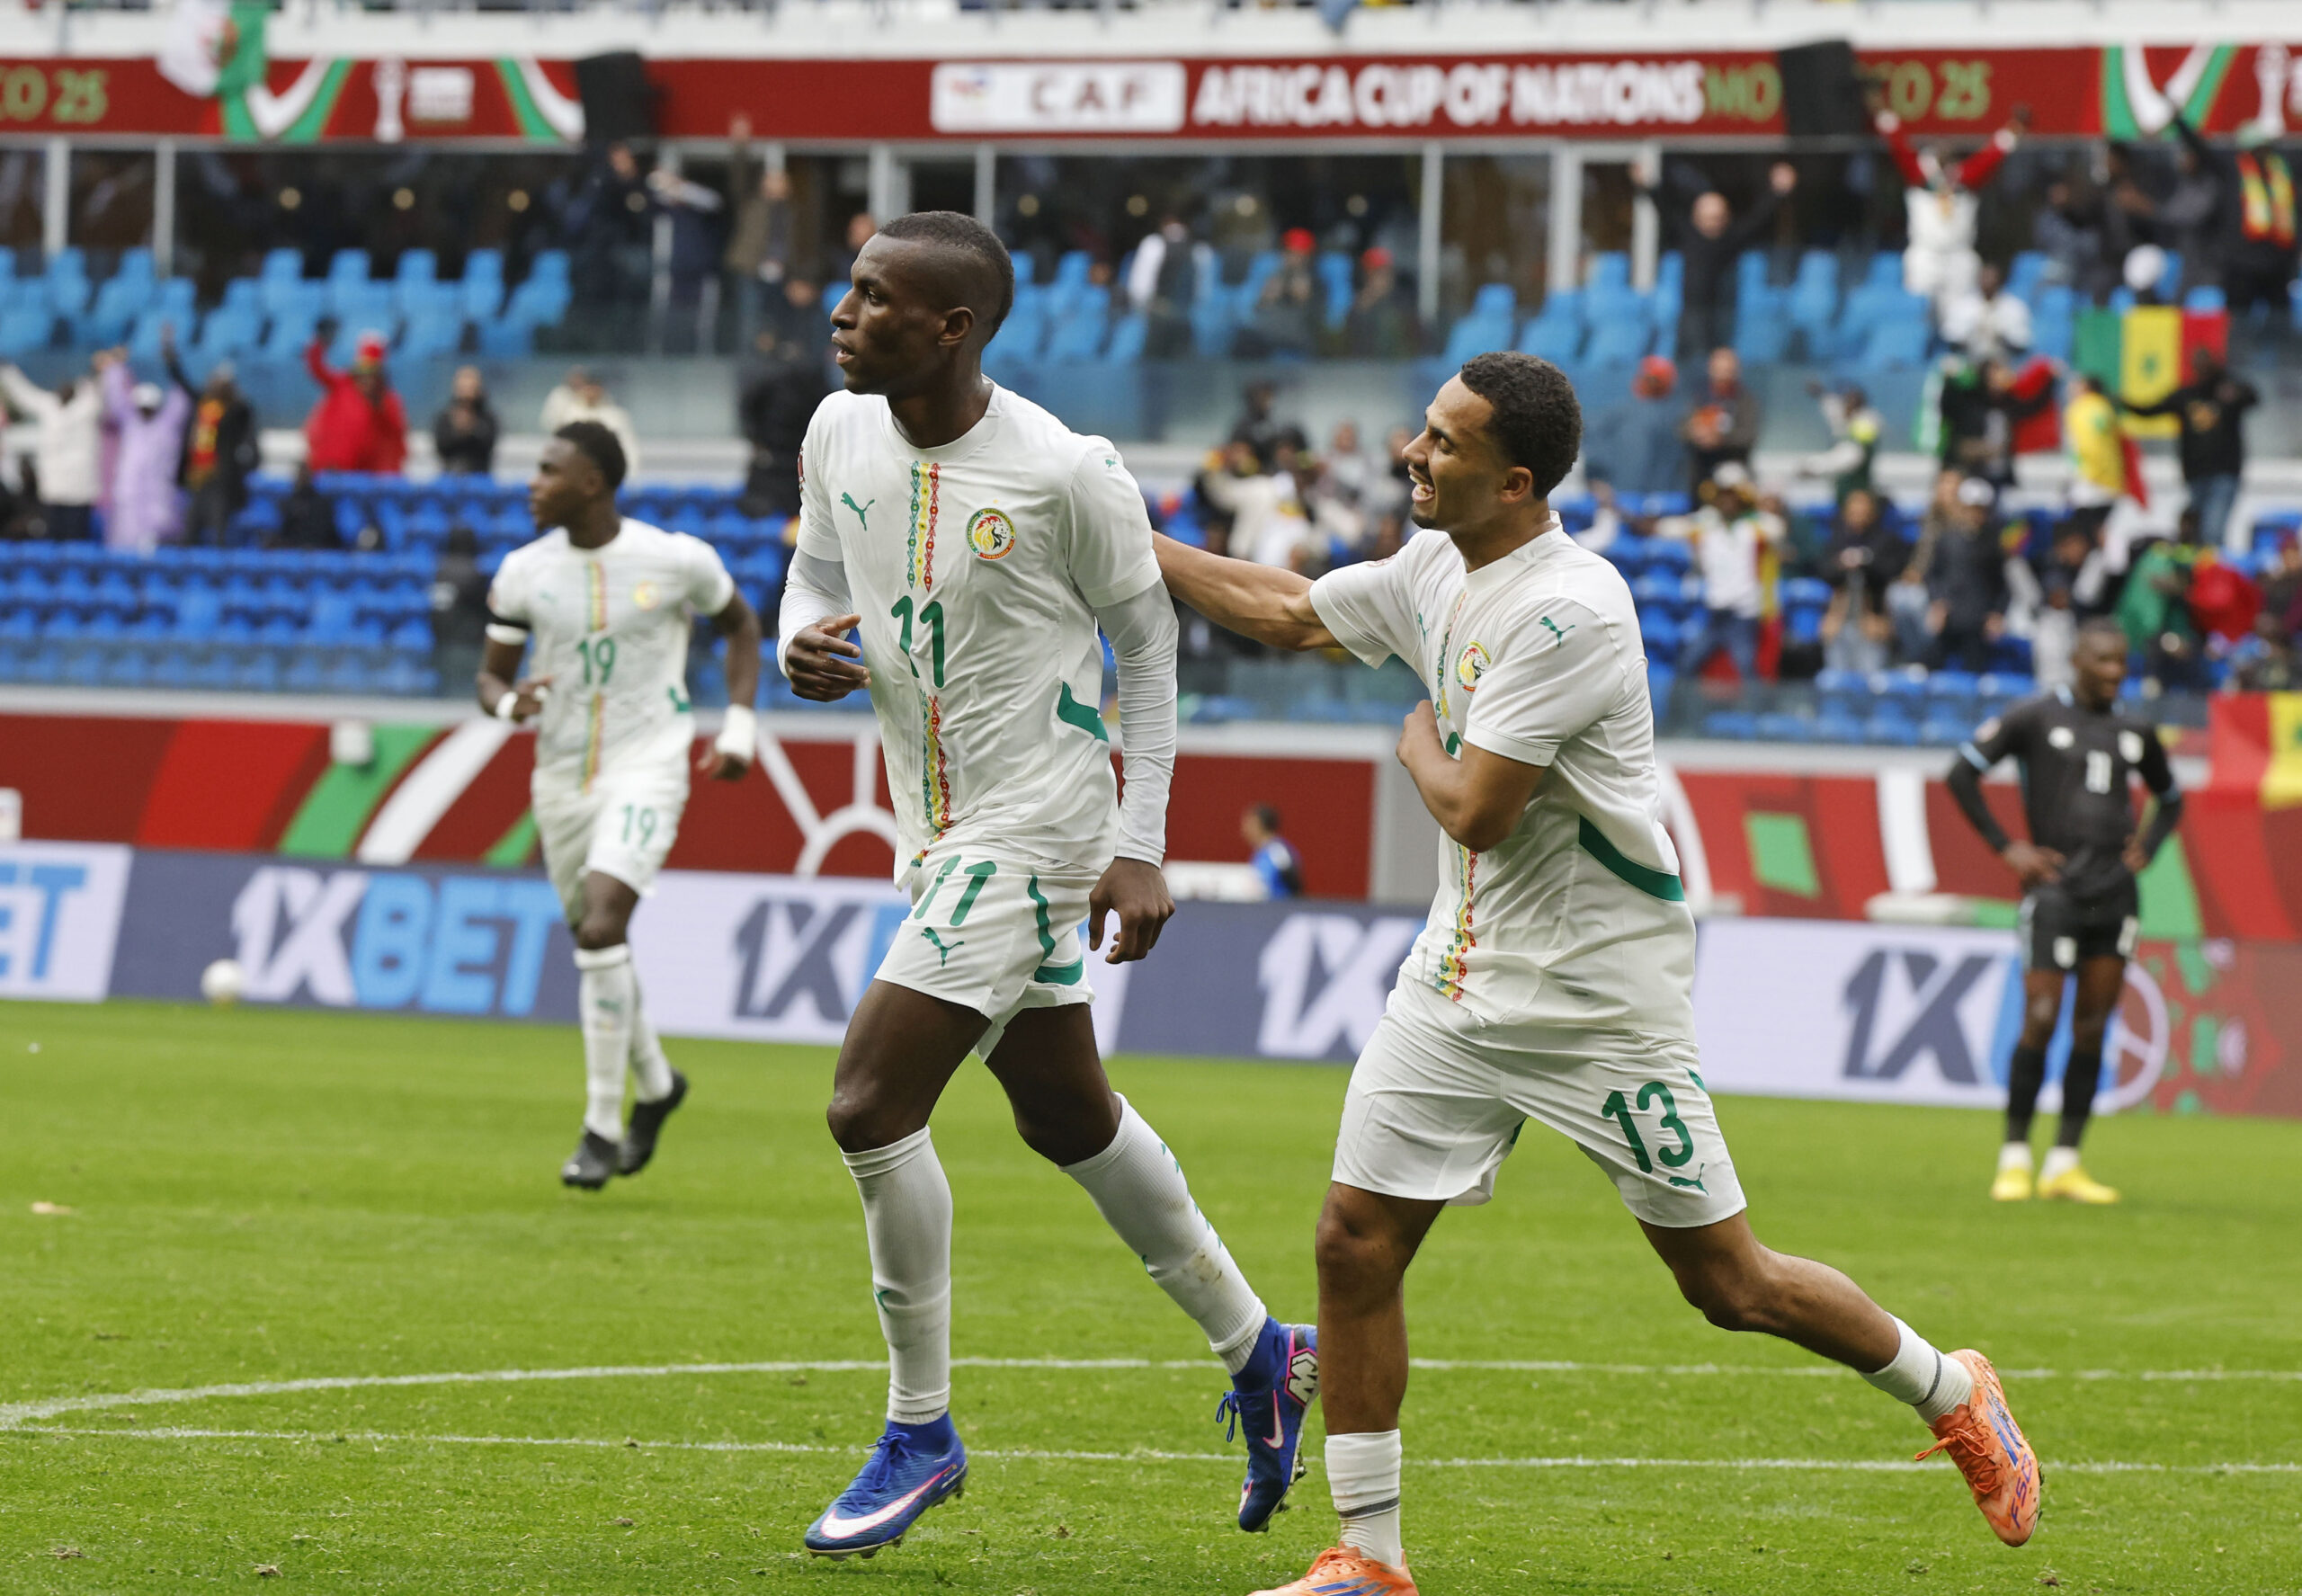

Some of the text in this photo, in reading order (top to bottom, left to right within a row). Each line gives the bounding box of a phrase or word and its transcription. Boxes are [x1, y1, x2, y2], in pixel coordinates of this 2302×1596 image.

[0, 64, 48, 122] O
[1029, 69, 1148, 117] CAF
[1191, 65, 1351, 127] AFRICA
[1352, 63, 1441, 128] CUP
[1442, 62, 1511, 127] OF
[1512, 59, 1705, 124] NATIONS
[1937, 58, 1992, 120] 25
[576, 638, 616, 686] 19
[890, 595, 944, 689] 11
[619, 803, 656, 850] 19
[0, 863, 89, 980] T
[914, 854, 997, 927] 11
[232, 866, 564, 1017] 1XBET
[735, 895, 911, 1021] 1X
[1257, 914, 1428, 1058] 1X
[1602, 1081, 1694, 1174] 13
